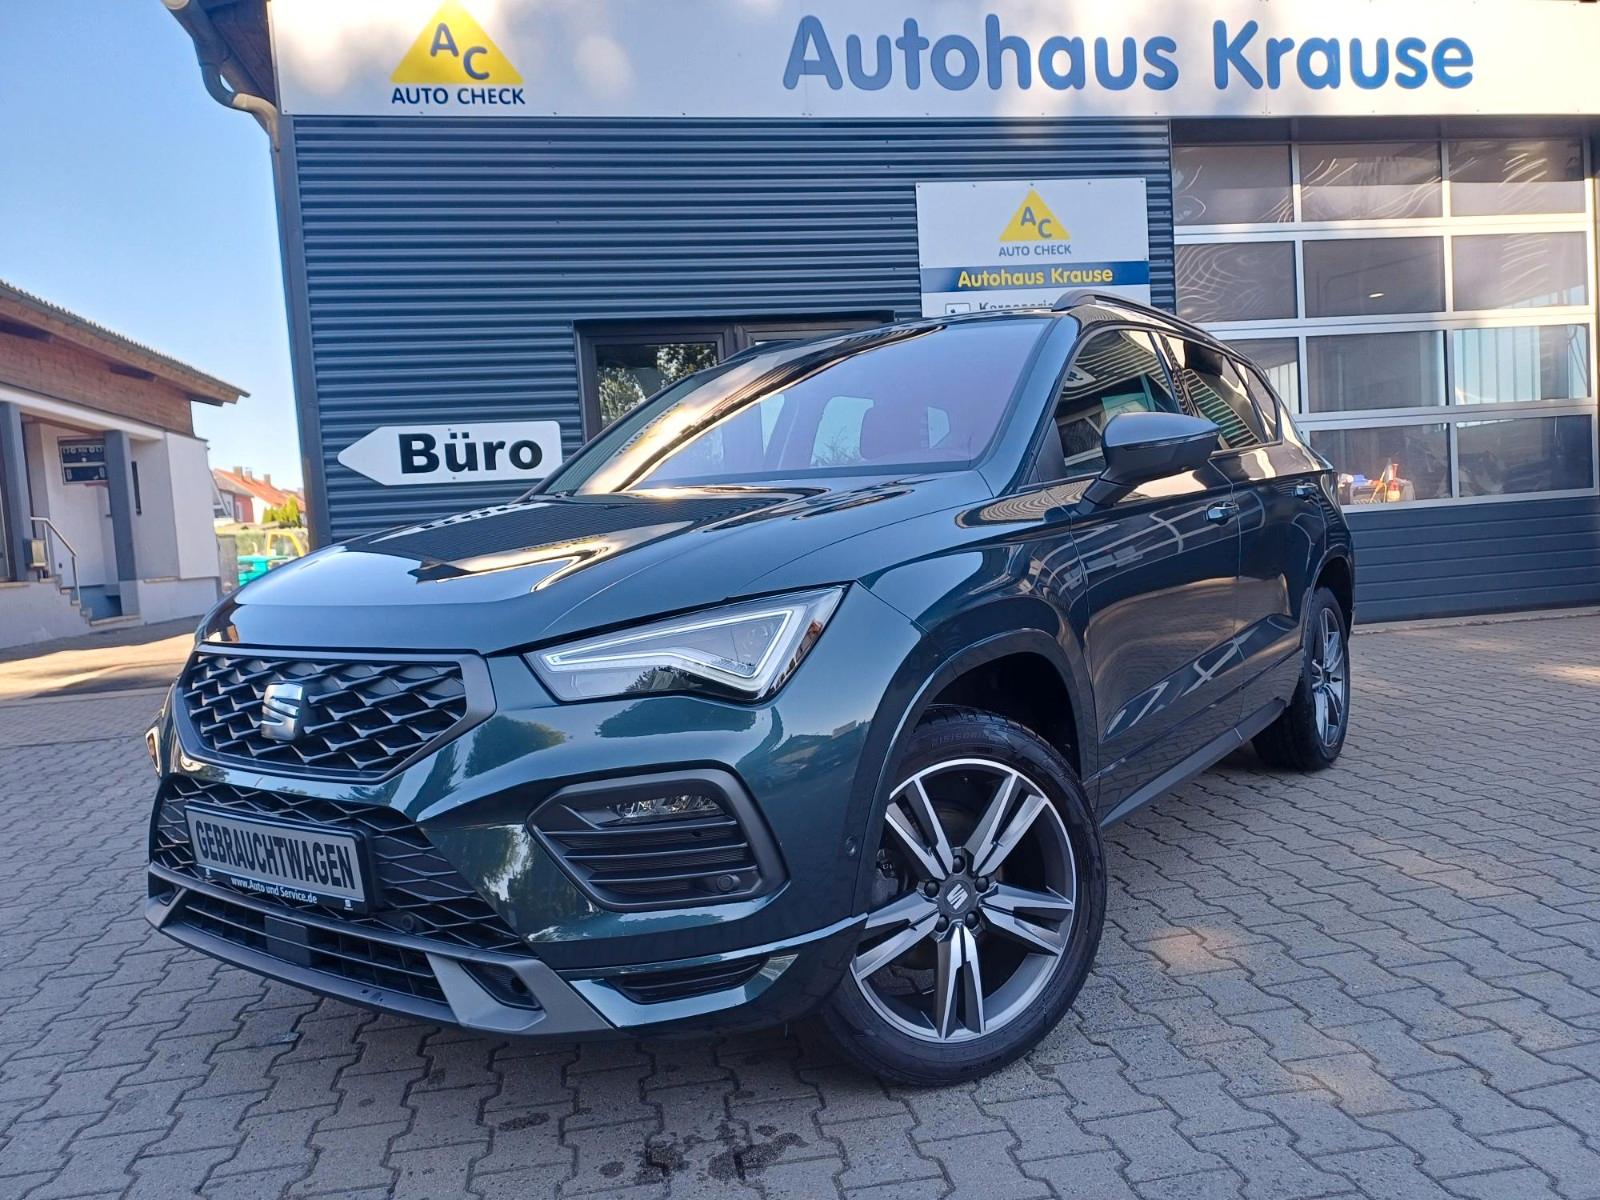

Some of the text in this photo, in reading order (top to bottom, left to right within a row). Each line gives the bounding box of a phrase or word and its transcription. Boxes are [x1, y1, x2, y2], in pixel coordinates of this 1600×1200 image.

[782, 14, 1474, 91] Autohaus Krause
[391, 87, 525, 105] AUTO CHECK
[998, 243, 1072, 257] AUTO CHECK
[958, 267, 1114, 288] Autohaus Krause
[398, 431, 543, 474] Büro
[194, 819, 357, 890] GEBRAUCHTWAGEN
[265, 885, 280, 897] und
[280, 886, 318, 904] Service.de
